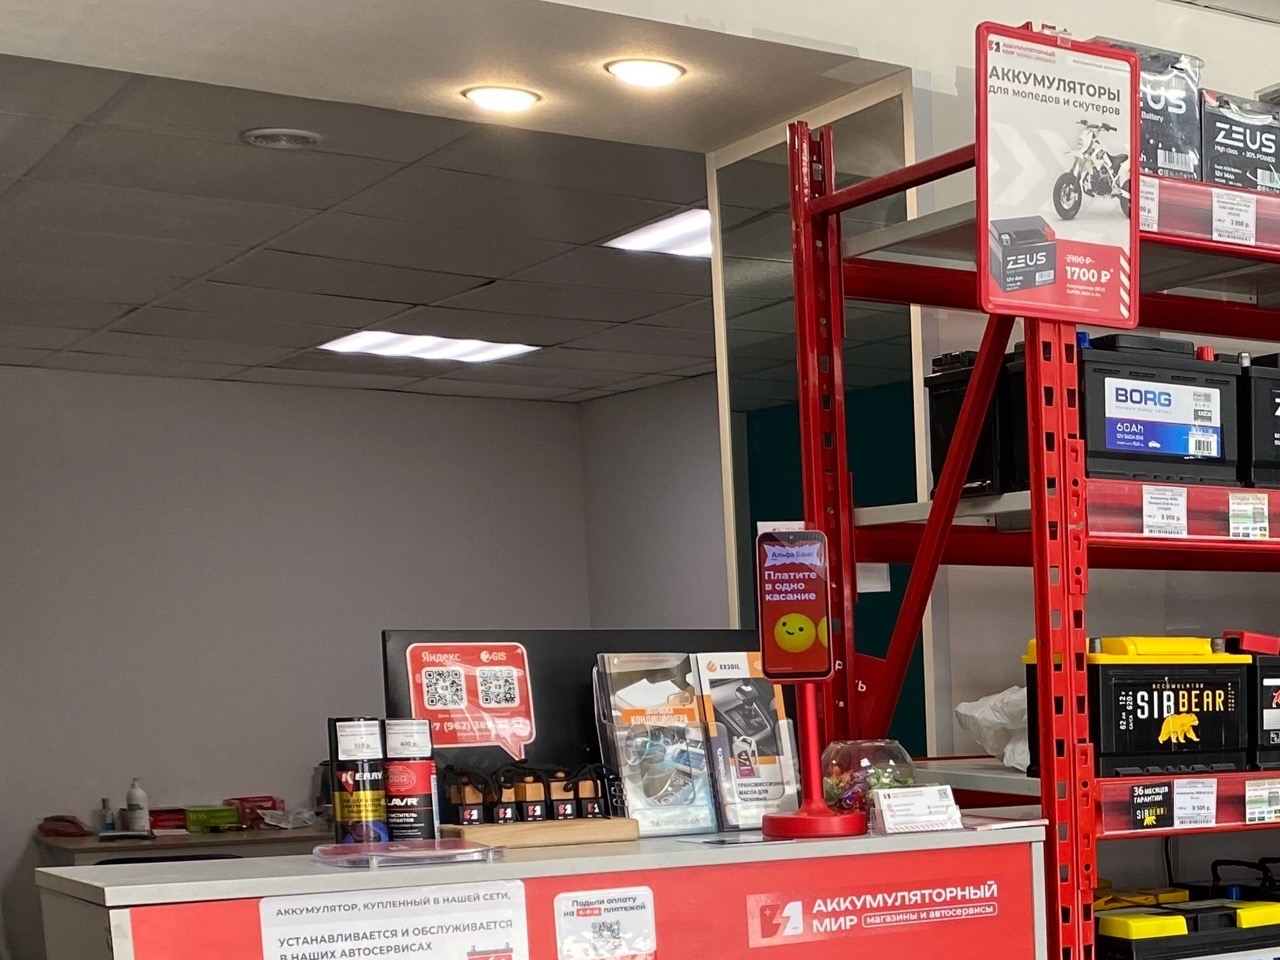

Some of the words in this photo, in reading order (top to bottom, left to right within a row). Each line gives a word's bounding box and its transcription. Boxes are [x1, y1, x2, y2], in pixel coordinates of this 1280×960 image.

[989, 66, 1121, 103] АККУМУЛЯТОРЫ
[988, 84, 1010, 97] для
[1012, 88, 1060, 108] мопедов
[1063, 97, 1070, 106] и
[1073, 99, 1121, 116] скутеров
[1215, 122, 1276, 153] ZEUS
[1006, 251, 1047, 268] ZEUS
[1065, 266, 1097, 282] 1700
[1115, 387, 1172, 407] BORG
[1116, 422, 1144, 434] 60Ah
[765, 571, 817, 579] Платите
[775, 583, 805, 591] одно
[766, 593, 816, 601] касание
[421, 651, 460, 663] Яндекс
[1137, 690, 1225, 719] SIBBEAR
[431, 722, 440, 731] 7
[444, 722, 471, 732] (962)
[341, 771, 383, 785] KERRY
[1133, 786, 1144, 796] 36
[1144, 786, 1169, 795] МЕСЯЦЕВ
[1134, 794, 1163, 804] ГАРАНТИИ
[276, 903, 361, 917] АККУМУЛЯТОР,
[363, 897, 431, 911] КУПЛЕННЫЙ
[433, 897, 440, 905] В
[442, 893, 481, 904] НАШЕЙ
[483, 892, 511, 901] СЕТИ,
[572, 899, 604, 907] Подели
[607, 896, 636, 904] оплату
[812, 880, 997, 914] АККУМУЛЯТОРНЫЙ
[604, 902, 645, 913] платежей
[812, 915, 857, 933] МИР
[867, 913, 918, 924] магазины
[920, 911, 927, 919] и
[929, 904, 994, 920] автосервисы
[278, 929, 398, 948] УСТАНАВЛИВАЕТСЯ
[401, 928, 409, 938] И
[412, 920, 513, 937] ОБСЛУЖИВАЕТСЯ
[339, 942, 432, 958] АВТОСЕРВИСАХ
